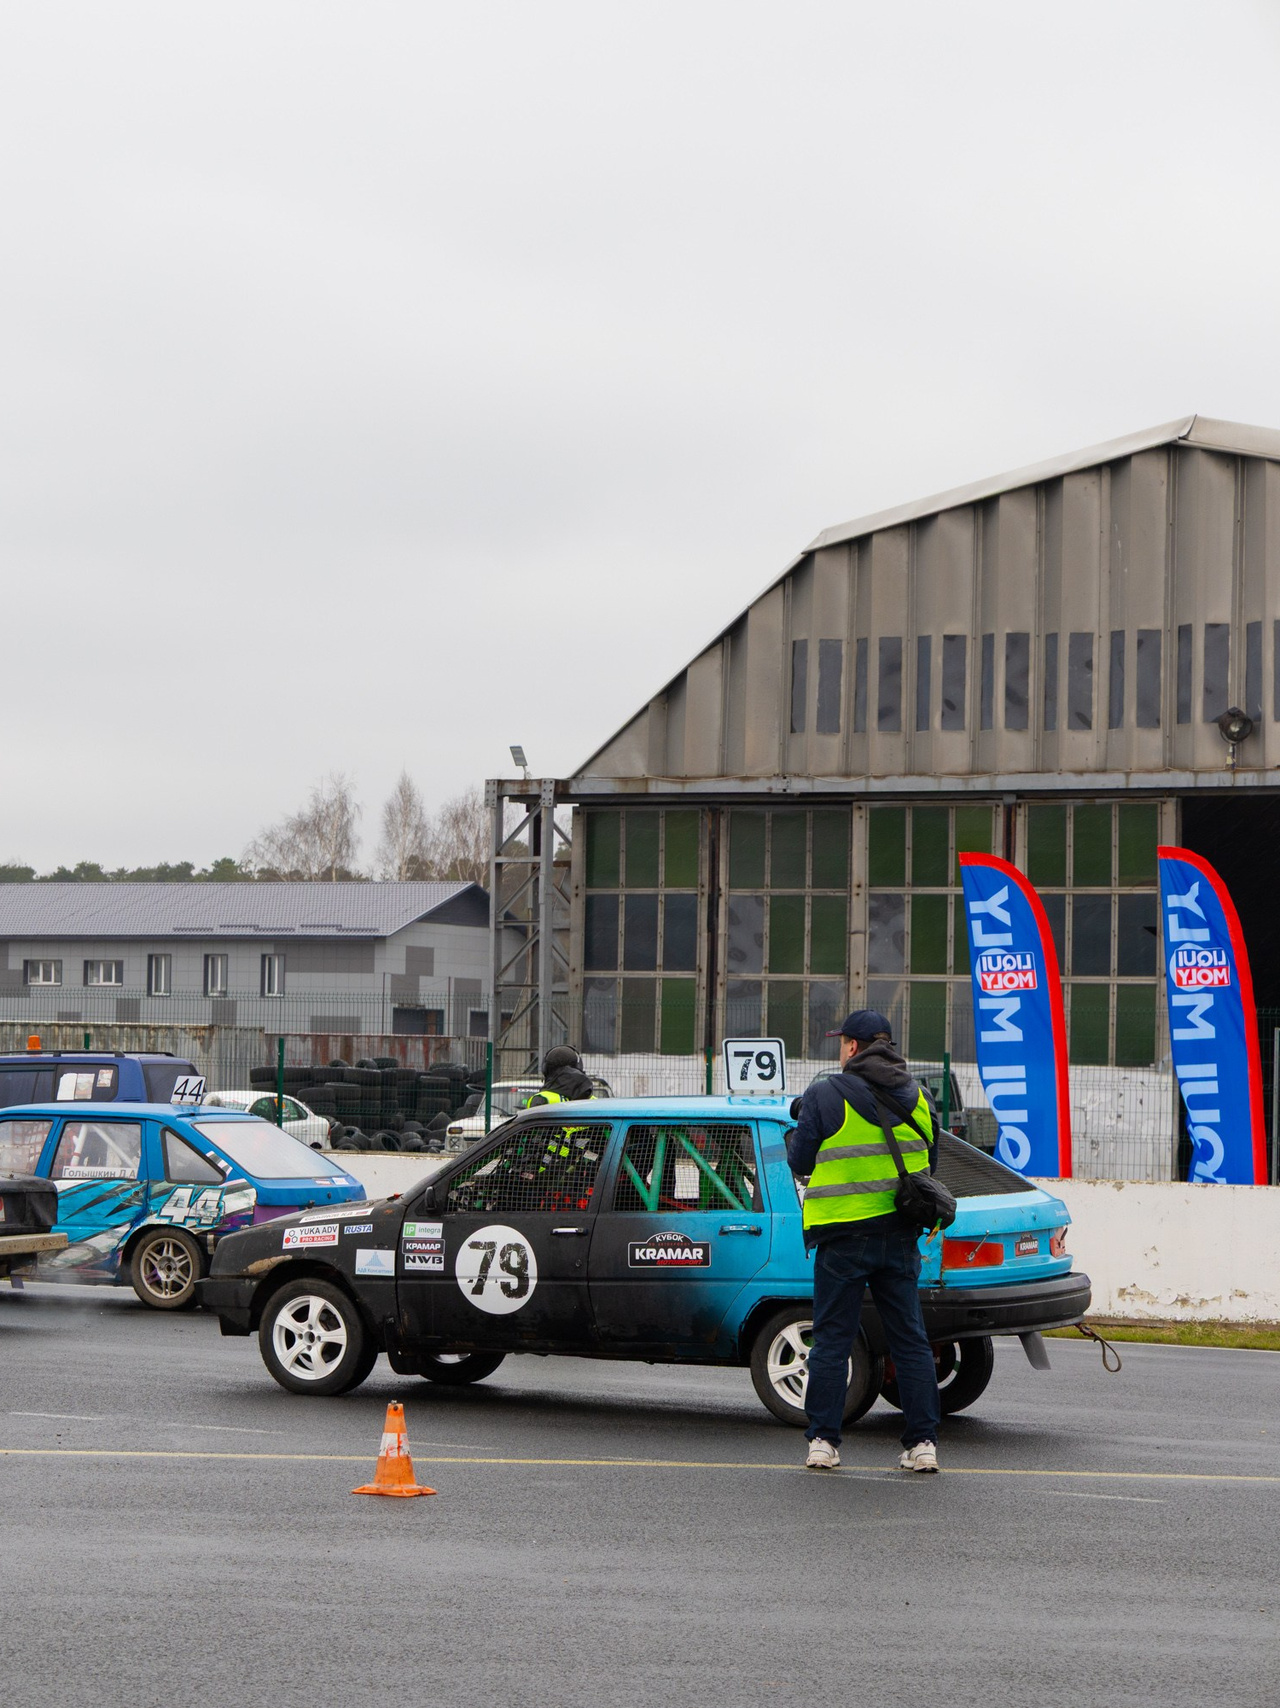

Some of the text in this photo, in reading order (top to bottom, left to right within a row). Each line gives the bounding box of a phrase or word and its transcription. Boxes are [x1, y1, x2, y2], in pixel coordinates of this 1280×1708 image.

[733, 1050, 777, 1081] 79
[174, 1078, 203, 1102] 44
[63, 1167, 116, 1178] Голышкин
[158, 1186, 225, 1226] 44
[300, 1225, 338, 1236] YUKA ADV
[345, 1225, 372, 1233] RUSTA
[406, 1226, 441, 1235] IP integra
[655, 1234, 685, 1243] КУБОК
[635, 1247, 703, 1260] KRAMAR
[406, 1256, 443, 1264] NWB
[467, 1240, 531, 1299] 79
